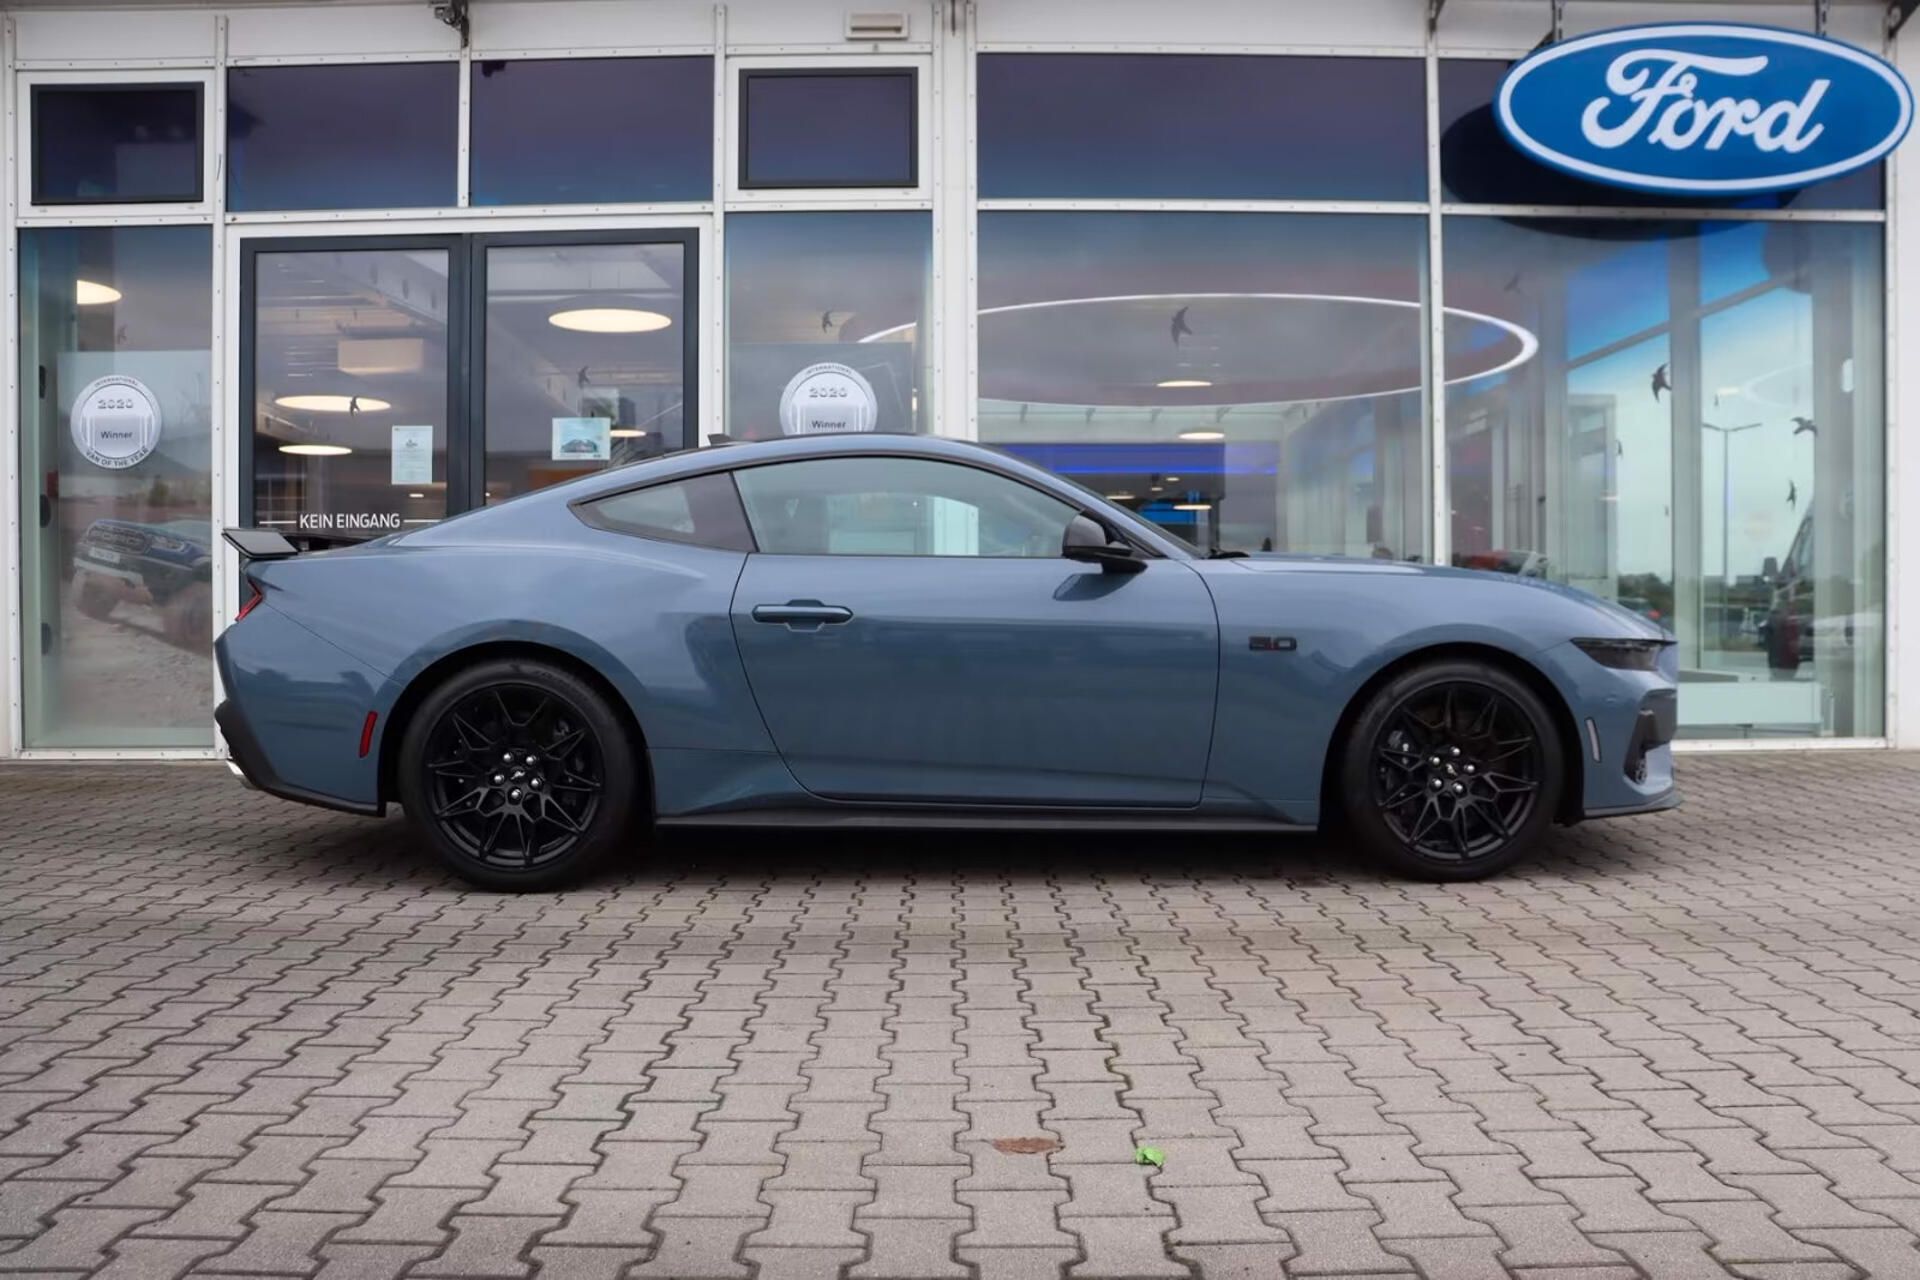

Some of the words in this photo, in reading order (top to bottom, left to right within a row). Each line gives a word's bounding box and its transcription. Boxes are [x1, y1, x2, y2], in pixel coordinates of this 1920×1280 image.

[1581, 48, 1831, 153] Ford
[809, 387, 848, 398] 2020
[97, 399, 134, 410] 2020
[811, 420, 846, 429] Winner
[100, 431, 133, 440] Winner
[86, 448, 100, 463] VAN
[101, 458, 112, 466] OF
[114, 459, 128, 467] THE
[300, 513, 333, 529] KEIN
[337, 513, 400, 529] EINGANG
